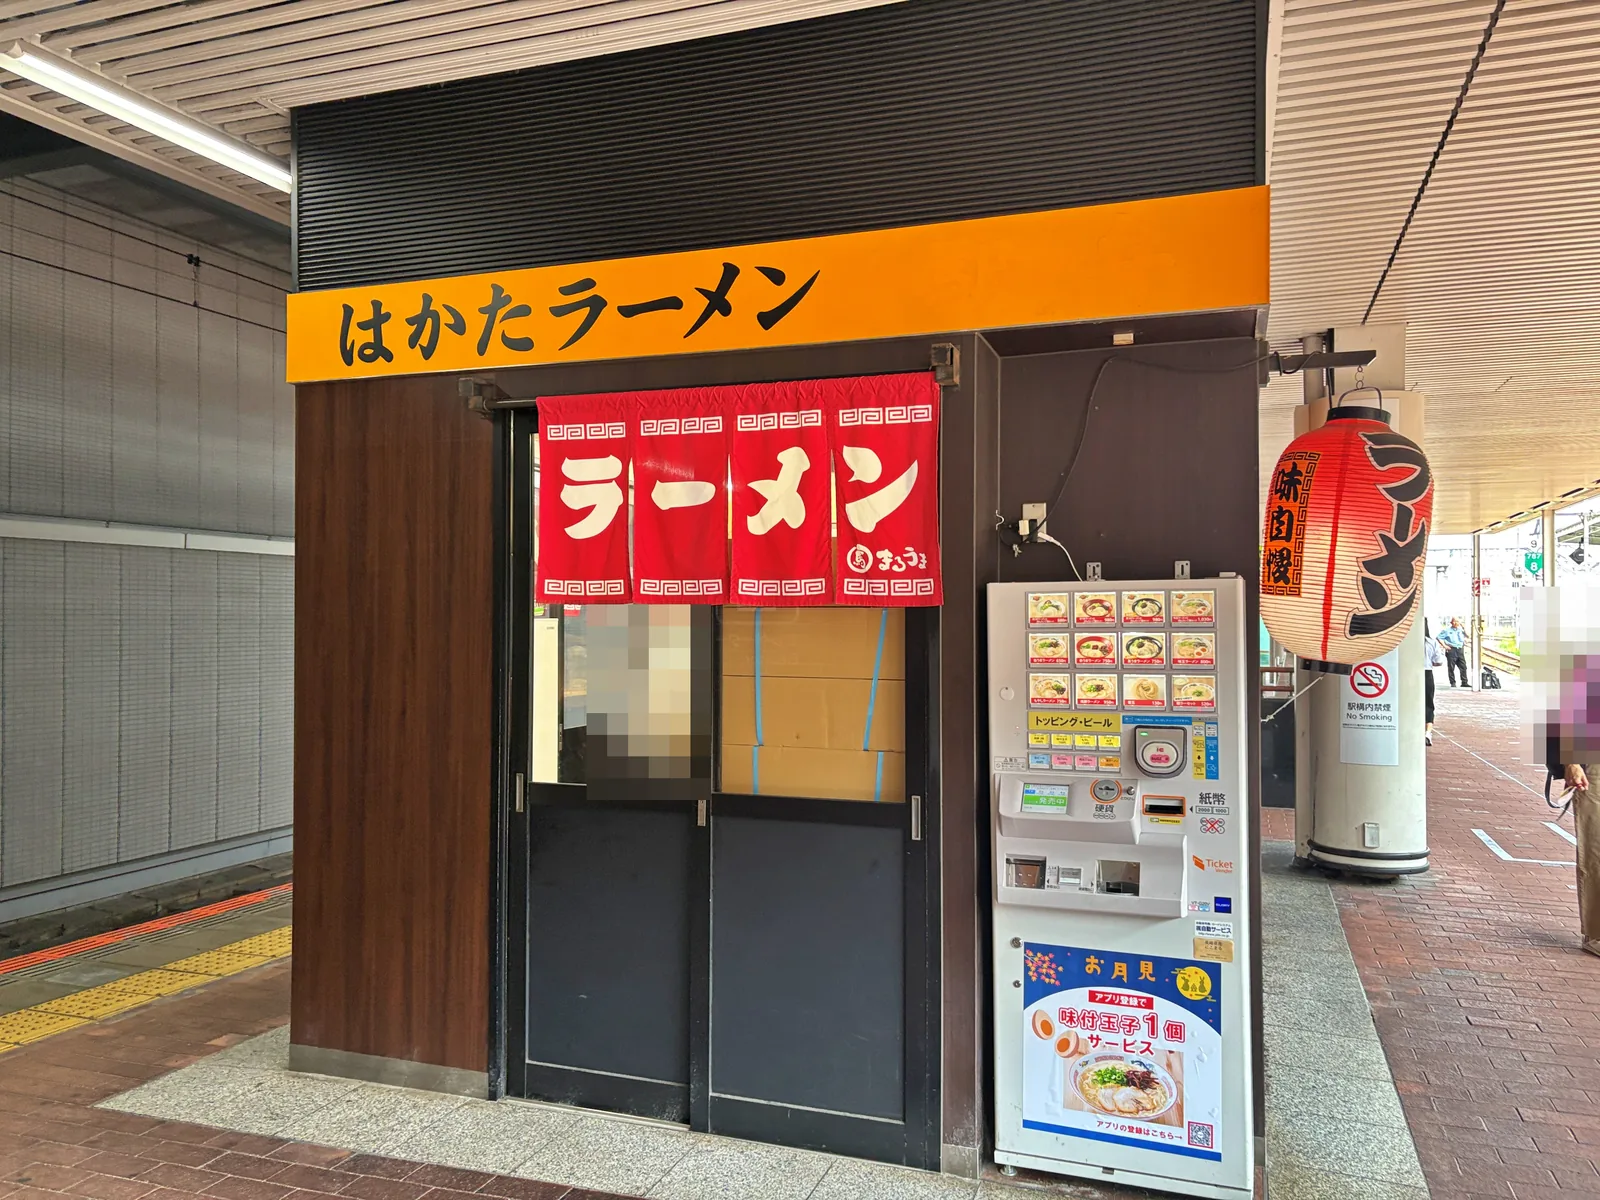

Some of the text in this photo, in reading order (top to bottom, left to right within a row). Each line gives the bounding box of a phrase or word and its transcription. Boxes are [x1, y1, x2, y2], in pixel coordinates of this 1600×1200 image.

[340, 261, 821, 367] はかたラーメン
[559, 445, 919, 540] ラーメン
[1345, 432, 1433, 640] ラーメン
[1530, 539, 1538, 549] 9
[876, 546, 928, 573] まるうま
[1530, 562, 1539, 571] 8
[1347, 702, 1392, 712] 駅構内禁煙
[1036, 715, 1113, 728] トッピング・ビール
[1346, 712, 1393, 722] No Smoking
[1039, 797, 1065, 805] 発売中
[1199, 792, 1226, 806] 紙幣
[1095, 804, 1115, 813] 硬貨
[1206, 858, 1233, 869] Ticket
[1085, 955, 1156, 983] お月見
[1094, 992, 1148, 1008] アプリ登録で
[1058, 1007, 1186, 1043] 味付玉子1個
[1087, 1033, 1155, 1056] サービス
